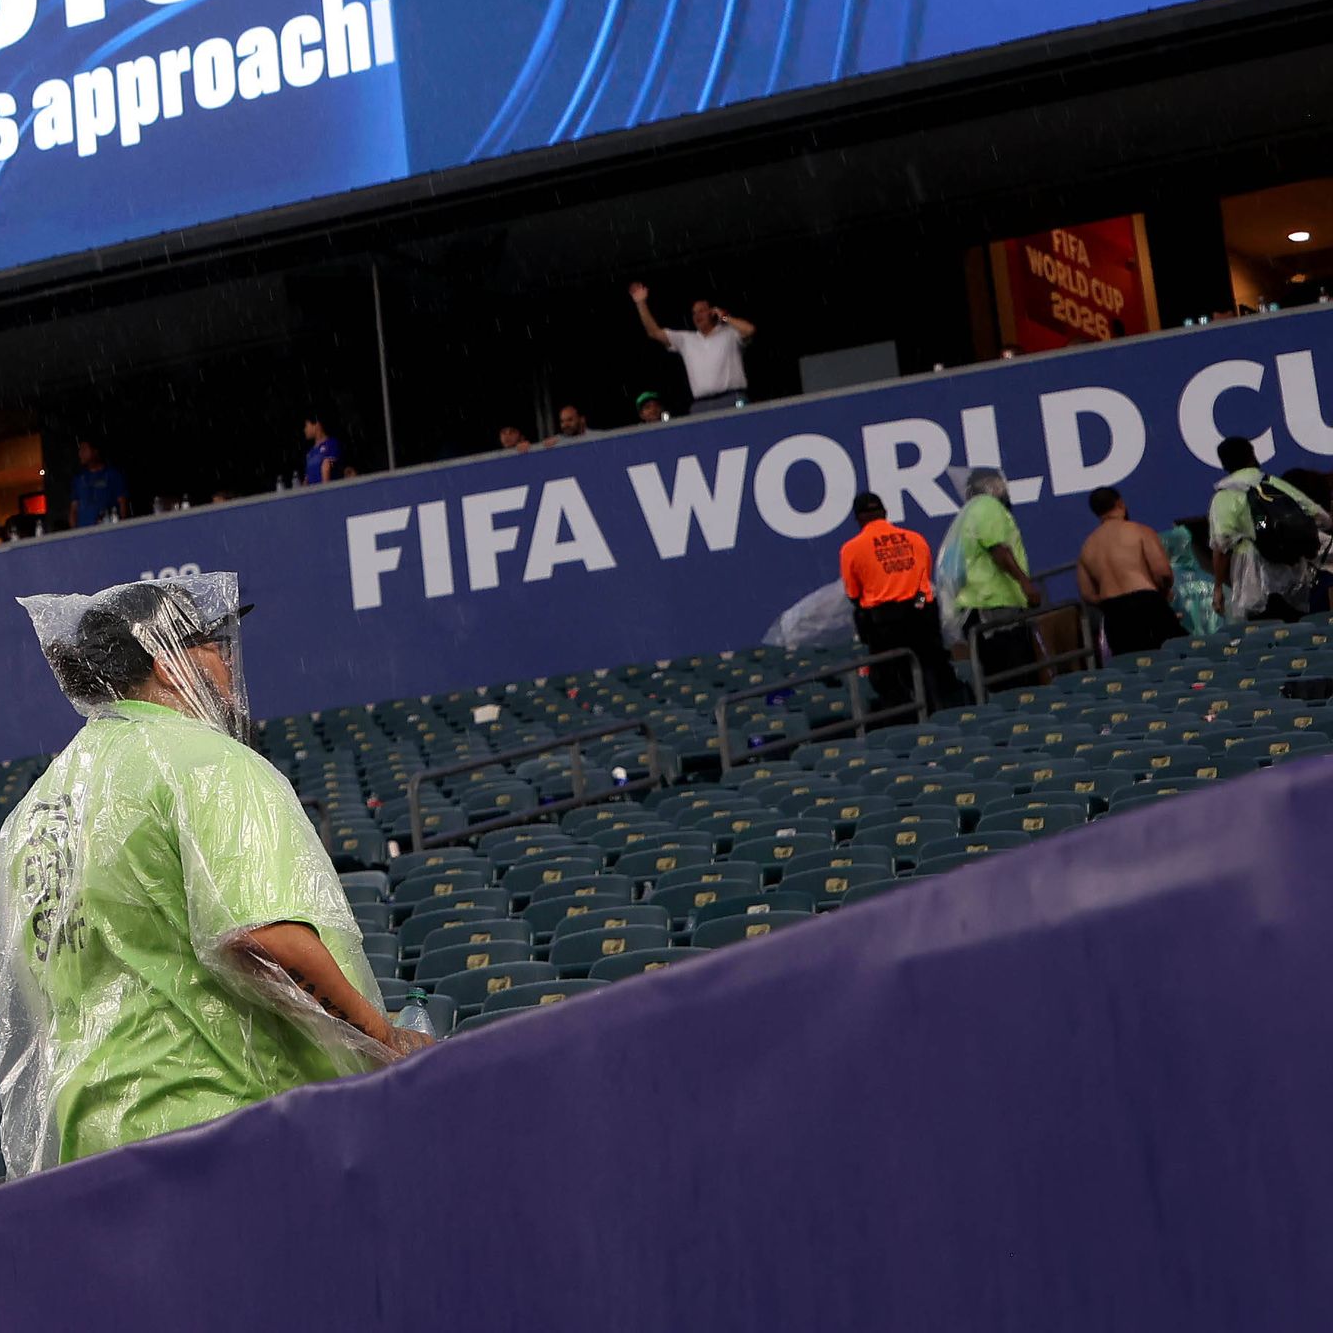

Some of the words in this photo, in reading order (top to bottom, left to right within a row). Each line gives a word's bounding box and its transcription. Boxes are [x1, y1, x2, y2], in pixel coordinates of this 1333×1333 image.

[1051, 228, 1091, 269] FIFA
[1024, 244, 1089, 299] WORLD
[1090, 277, 1125, 316] CUP
[346, 475, 617, 610] FIFA
[627, 385, 1146, 560] WORLD
[1178, 348, 1333, 472] CU
[873, 533, 910, 547] APEX
